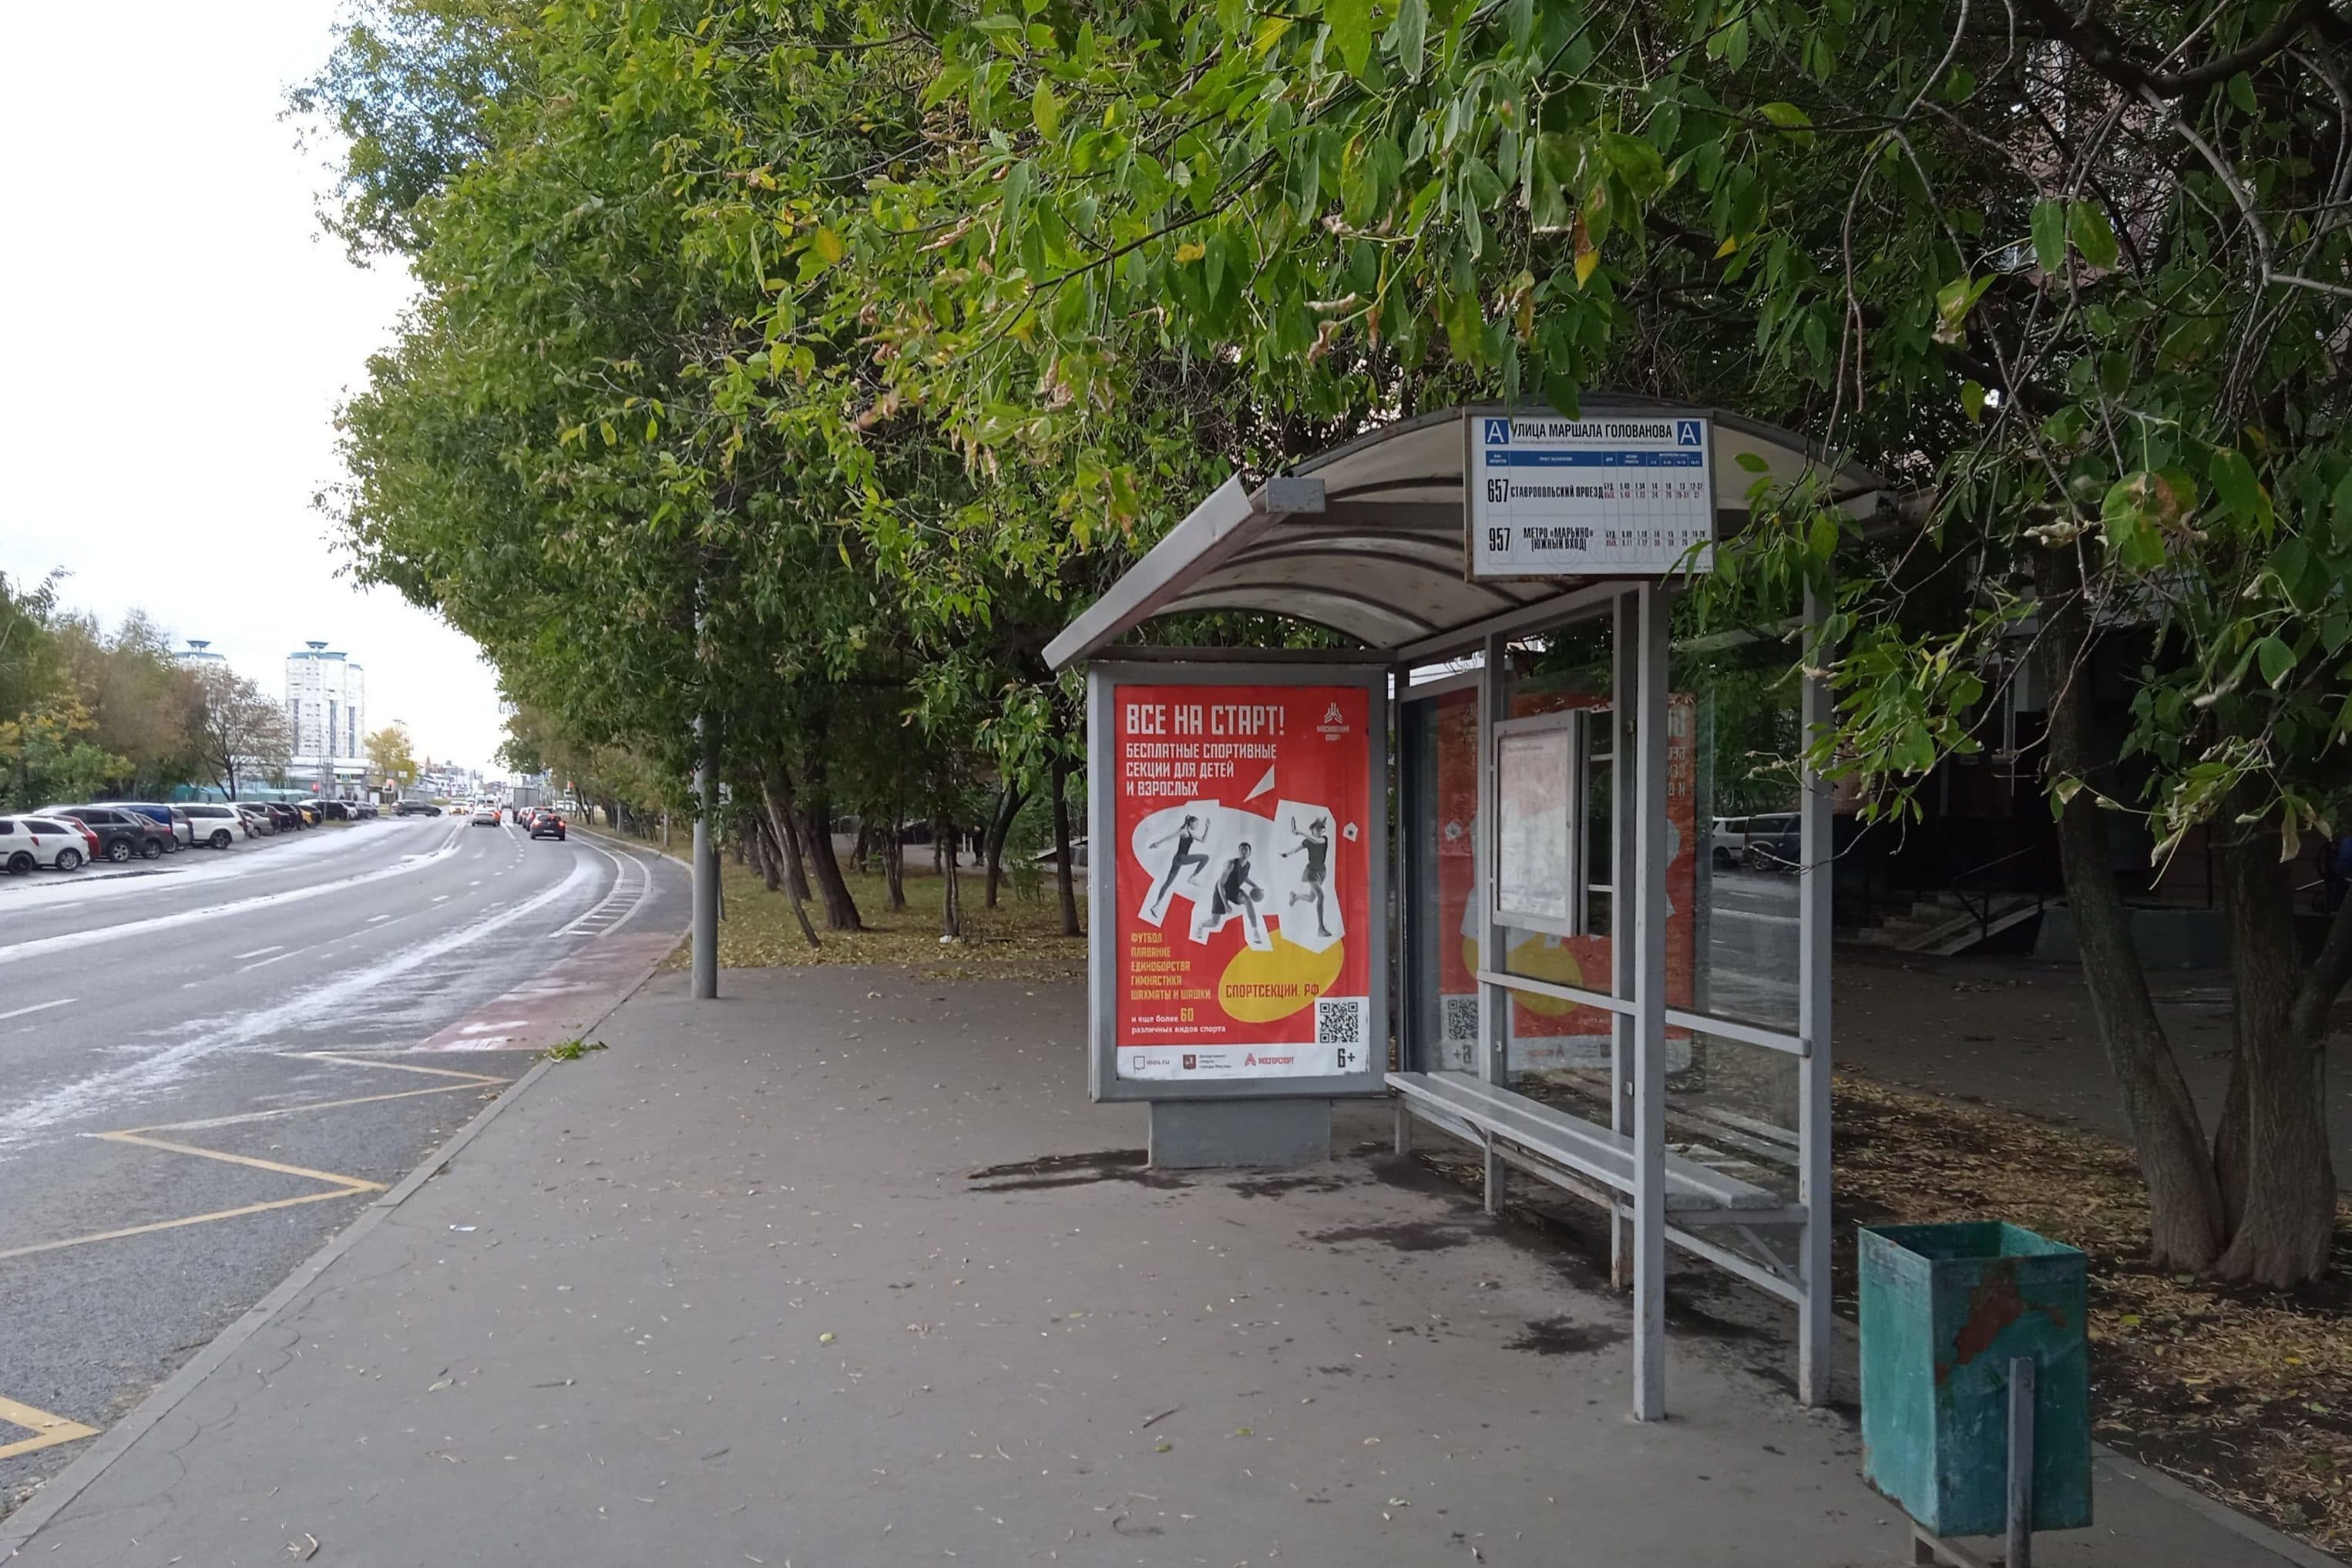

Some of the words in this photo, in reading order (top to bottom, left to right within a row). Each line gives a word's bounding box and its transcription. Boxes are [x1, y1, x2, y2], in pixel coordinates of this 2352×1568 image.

[1487, 421, 1505, 444] А
[1512, 423, 1547, 439] УЛИЦА
[1549, 424, 1603, 438] МАРШАЛА
[1605, 425, 1672, 438] ГОЛОВАНОВА
[1680, 422, 1698, 445] А
[1487, 478, 1509, 502] 657
[1510, 485, 1574, 498] СТАВРОПОЛЬСКИЙ
[1576, 486, 1604, 499] ПРОЕЗД
[1489, 528, 1510, 551] 957
[1523, 527, 1548, 538] МЕТРО
[1550, 527, 1594, 539] «МАРЬИНО»
[1531, 539, 1563, 552] (ЮЖНЫЙ
[1565, 539, 1587, 551] ВХОД)
[1127, 704, 1166, 734] ВСЕ
[1174, 705, 1202, 734] НА
[1211, 706, 1285, 735] СТАРТ!
[1126, 743, 1199, 758] БЕСПЛАТНЫЕ
[1203, 744, 1276, 759] СПОРТИВНЫЕ
[1126, 762, 1170, 778] СЕКЦИИ
[1174, 762, 1196, 779] ДЛЯ
[1199, 760, 1234, 779] ДЕТЕЙ
[1126, 781, 1134, 796] И
[1137, 781, 1198, 796] ВЗРОСЛЫХ
[1131, 933, 1162, 943] ФУТБОЛ
[1131, 947, 1171, 957] ПЛАВАНИЕ
[1131, 961, 1190, 972] ЕДИНОБОРСТВА
[1131, 975, 1181, 985] ГИМНАСТИКА
[1131, 989, 1171, 1000] ШАХМАТЫ
[1173, 989, 1179, 999] И
[1181, 989, 1211, 999] ШАШКИ
[1304, 983, 1319, 996] РФ
[1180, 1007, 1194, 1022] 60
[1131, 1026, 1172, 1035] различных
[1200, 1026, 1226, 1034] спорта
[1337, 1048, 1356, 1068] 6+
